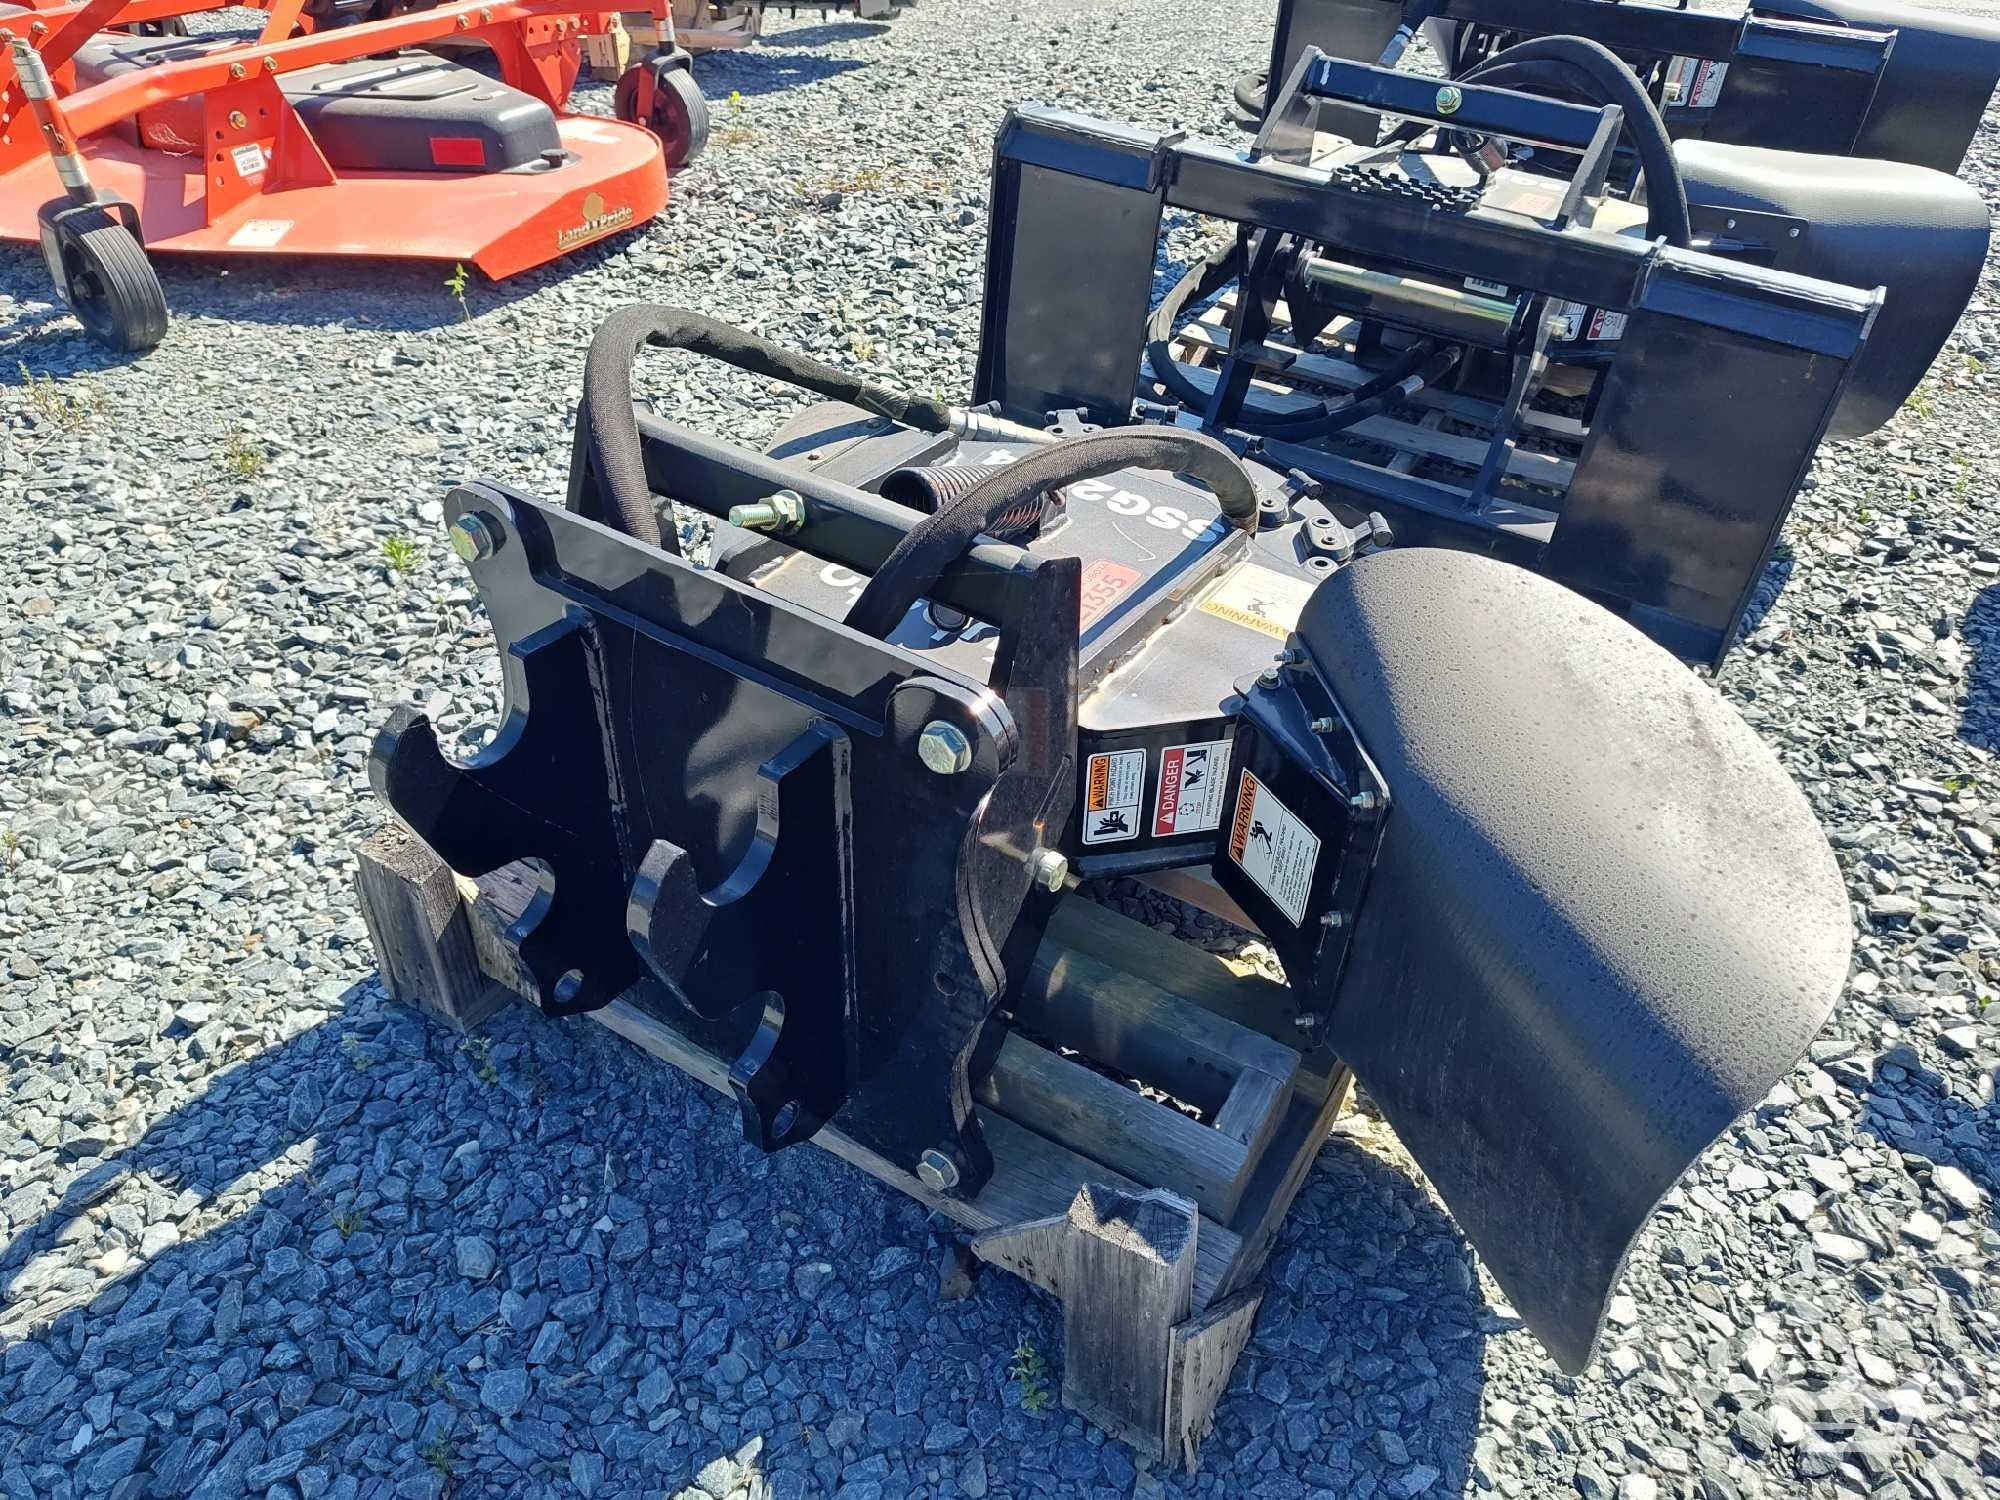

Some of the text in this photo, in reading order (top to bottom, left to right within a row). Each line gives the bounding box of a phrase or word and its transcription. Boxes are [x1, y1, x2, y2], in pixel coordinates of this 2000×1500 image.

[558, 207, 633, 241] Land Pride
[1204, 602, 1280, 635] WARNING
[1092, 757, 1106, 799] WARNING
[1163, 758, 1181, 811] DANGER
[1233, 776, 1257, 848] WARNING
